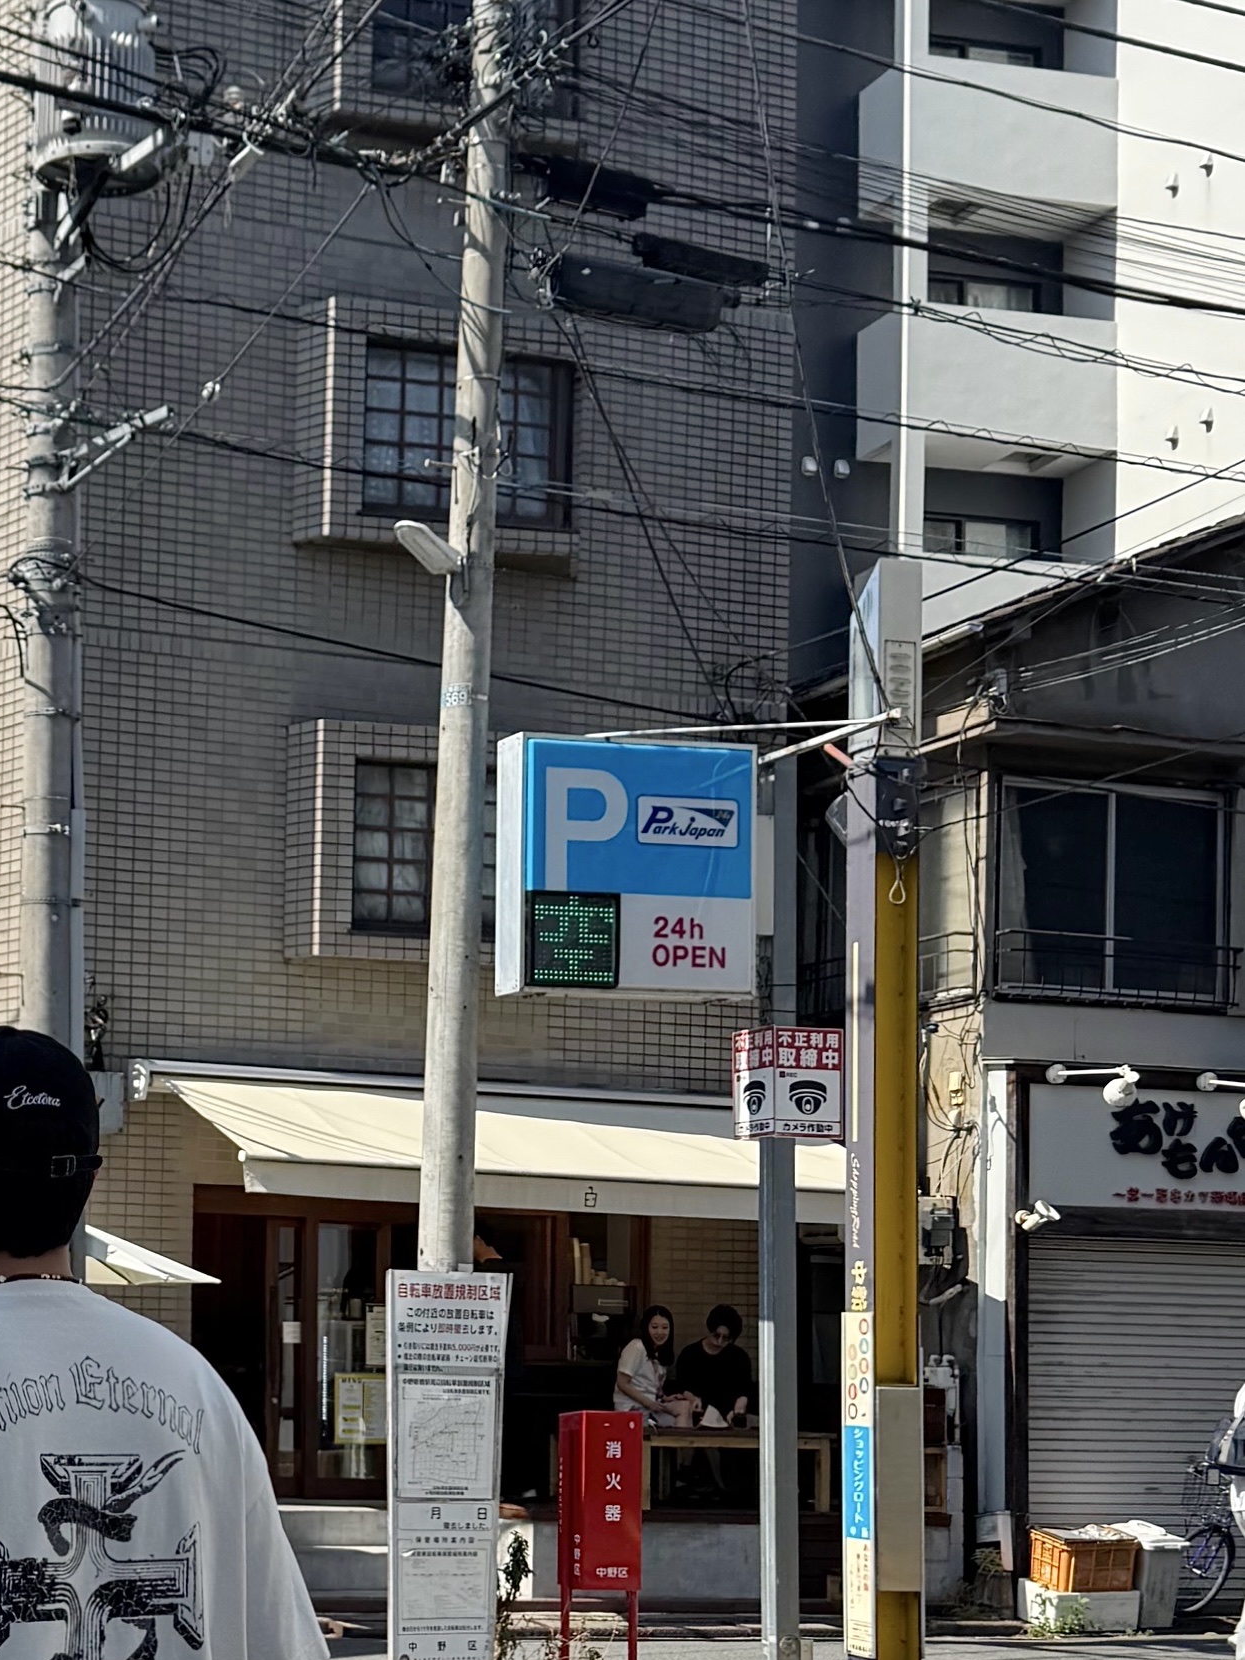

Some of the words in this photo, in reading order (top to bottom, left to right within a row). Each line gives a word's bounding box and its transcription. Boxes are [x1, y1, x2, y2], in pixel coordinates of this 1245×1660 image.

[545, 766, 628, 891] P
[641, 805, 678, 834] Park
[678, 816, 726, 840] Japan
[653, 915, 704, 941] 24h
[534, 895, 614, 983] 空
[652, 944, 726, 969] OPEN
[735, 1030, 773, 1050] 不正利用
[778, 1031, 839, 1048] 不正利用
[778, 1049, 839, 1069] 取締中
[783, 1122, 834, 1133] カメラ作動中
[397, 1282, 501, 1301] 自転車放置規制区域
[405, 1306, 495, 1321] この付近の放置自転車は
[69, 1355, 204, 1455] Eternal
[605, 1440, 622, 1522] 消火器
[430, 1506, 442, 1520] 月
[477, 1507, 488, 1520] 日
[596, 1566, 629, 1578] 中野区
